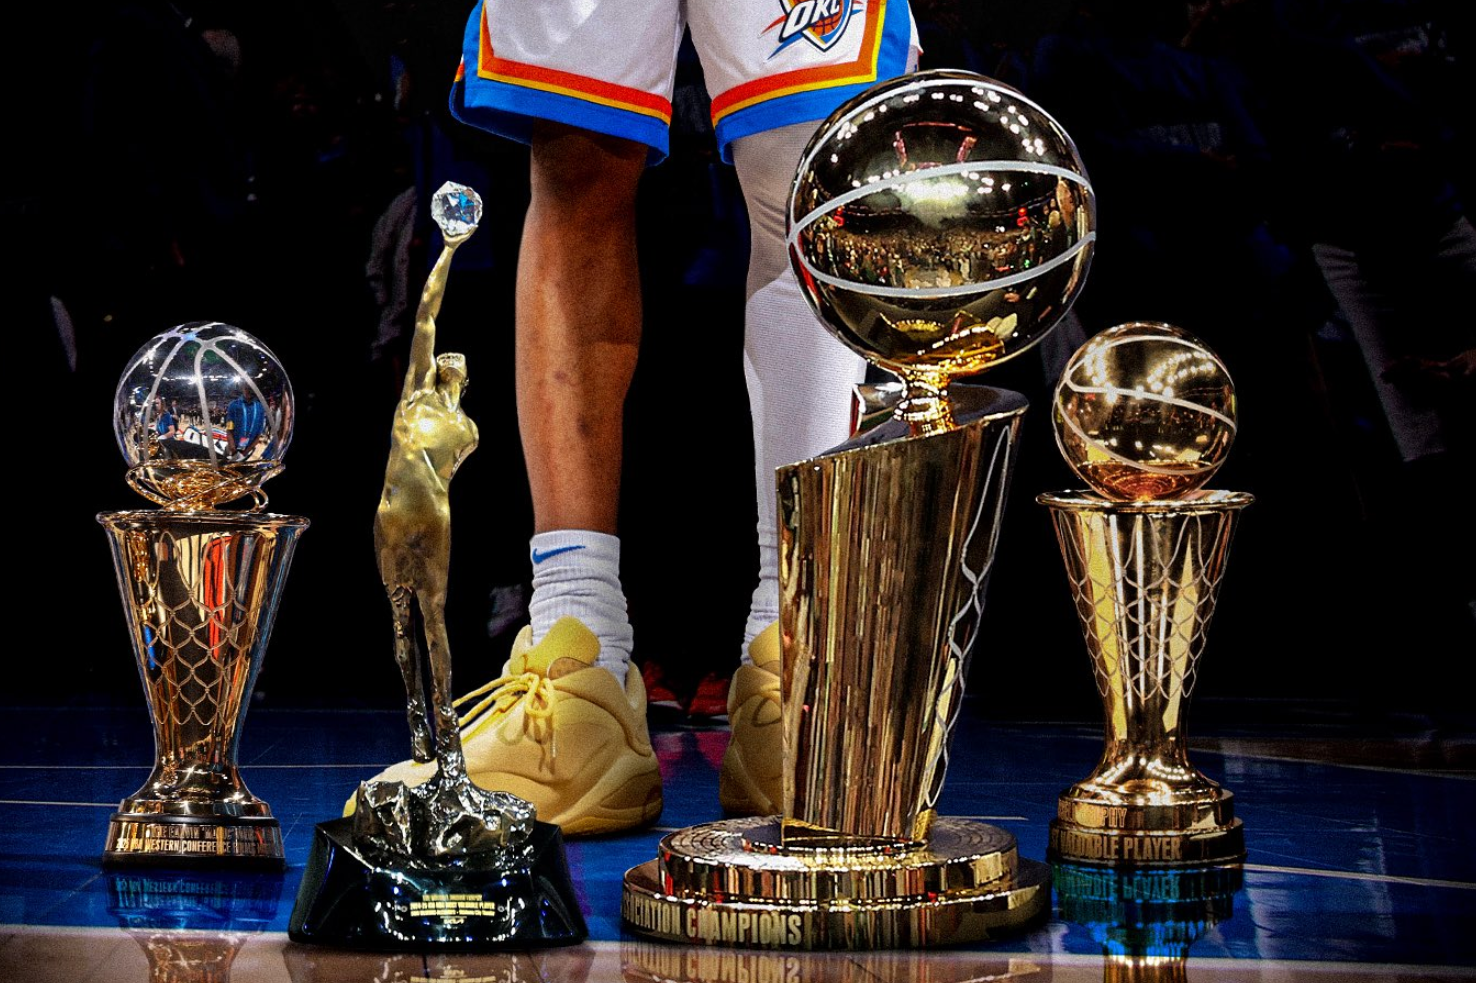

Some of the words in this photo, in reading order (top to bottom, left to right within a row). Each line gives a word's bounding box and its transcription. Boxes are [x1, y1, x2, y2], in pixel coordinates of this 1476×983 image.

[144, 837, 180, 852] WESTERN
[1124, 836, 1183, 861] PLAYER
[686, 907, 802, 947] CHAMPIONS
